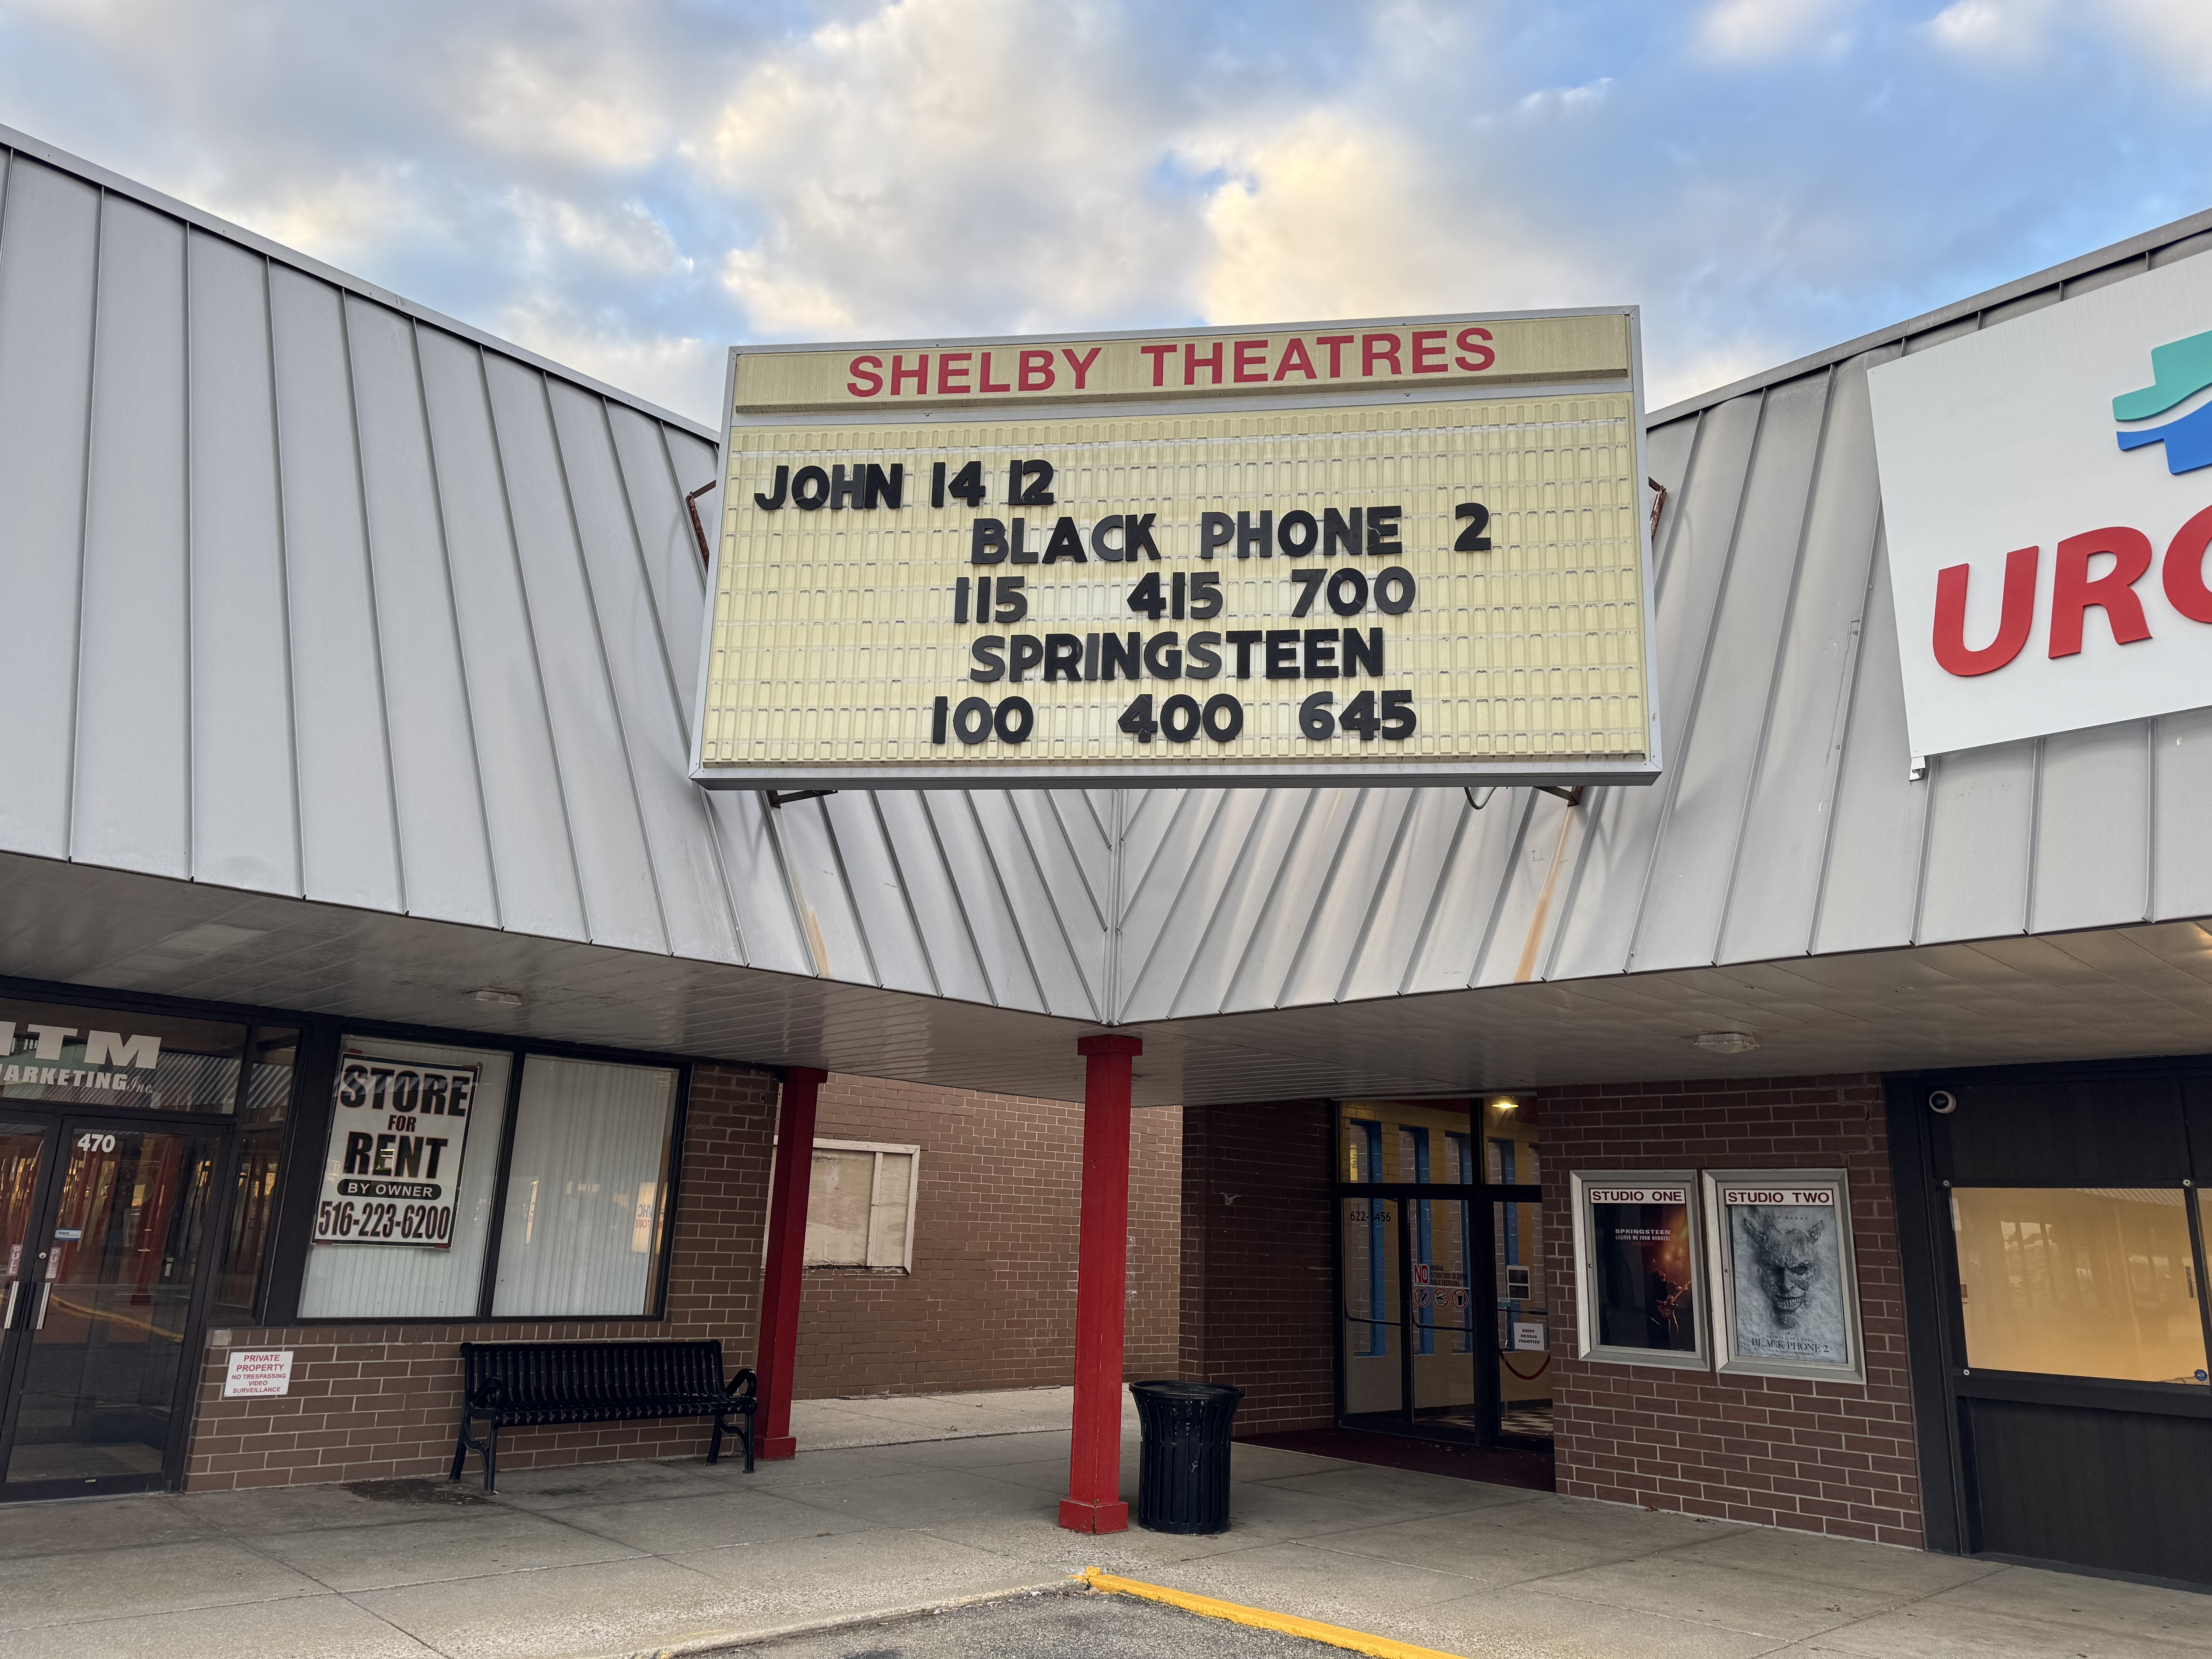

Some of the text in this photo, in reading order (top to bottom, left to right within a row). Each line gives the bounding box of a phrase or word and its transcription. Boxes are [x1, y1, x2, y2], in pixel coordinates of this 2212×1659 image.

[848, 328, 1495, 397] SHELBY THEATRES
[754, 459, 1054, 511] JOHN 14 12
[971, 502, 1491, 565] BLACK PHONE 2
[954, 566, 1416, 624] 115 415 700
[970, 627, 1384, 683] SPRINGSTEEN
[932, 690, 1417, 745] 100 400 645
[0, 1063, 154, 1094] ARKETING Inc.
[340, 1064, 471, 1117] STORE
[387, 1115, 417, 1132] FOR
[77, 1133, 115, 1153] 470
[342, 1131, 448, 1179] RENT
[347, 1182, 433, 1198] BY OWNER
[1592, 1190, 1683, 1202] STUDIO ONE
[1728, 1192, 1830, 1204] STUDIO TWO
[318, 1201, 451, 1240] 516-223-6200
[9, 1246, 21, 1274] PULL
[1413, 1264, 1429, 1285] NO
[1752, 1338, 1784, 1349] BLACK
[1787, 1341, 1821, 1352] PHONE
[1822, 1345, 1829, 1353] 2
[236, 1364, 285, 1372] PROPERTY
